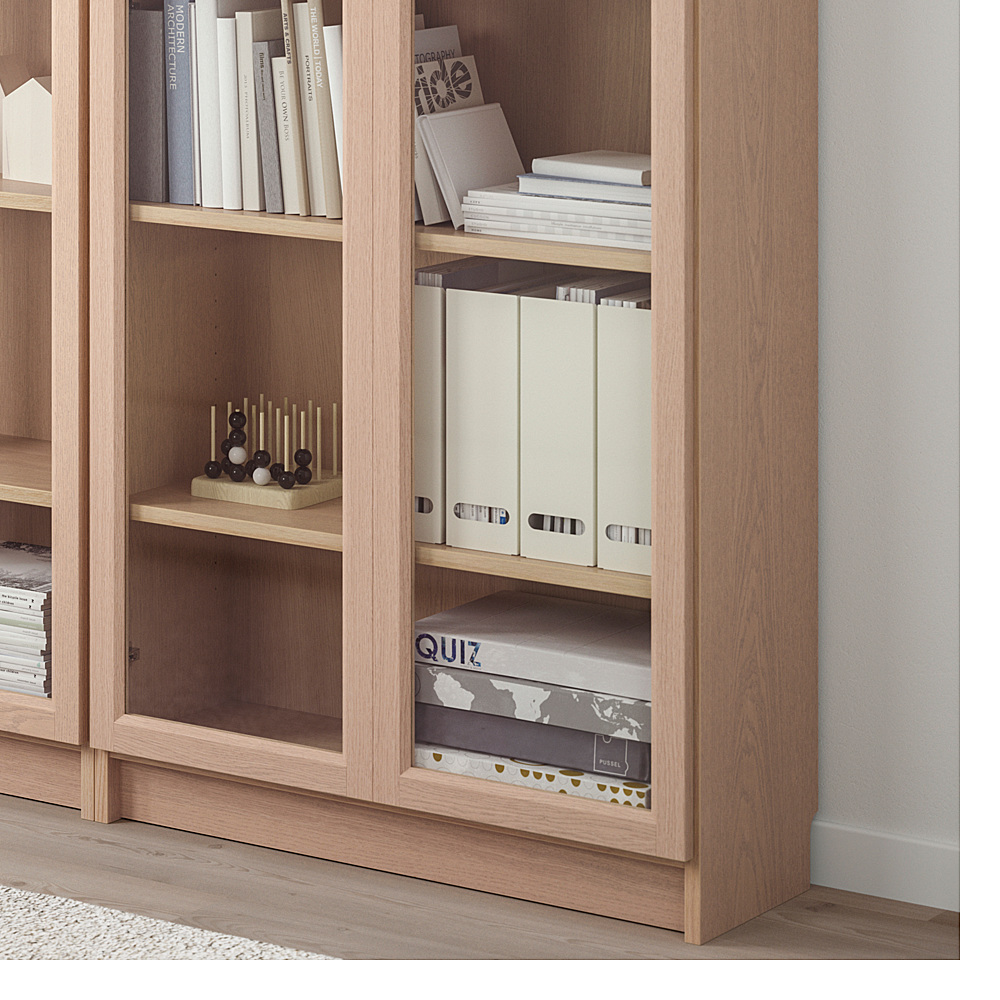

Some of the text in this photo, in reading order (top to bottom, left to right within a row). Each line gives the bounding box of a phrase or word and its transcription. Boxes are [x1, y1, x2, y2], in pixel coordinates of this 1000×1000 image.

[167, 4, 177, 90] ARCHITECTURE
[175, 4, 185, 53] MODERN
[310, 6, 323, 89] THE WORLD TODAY
[305, 55, 313, 102] PORTRAITS
[415, 633, 482, 667] QUIZ
[599, 759, 621, 768] PUSSEL
